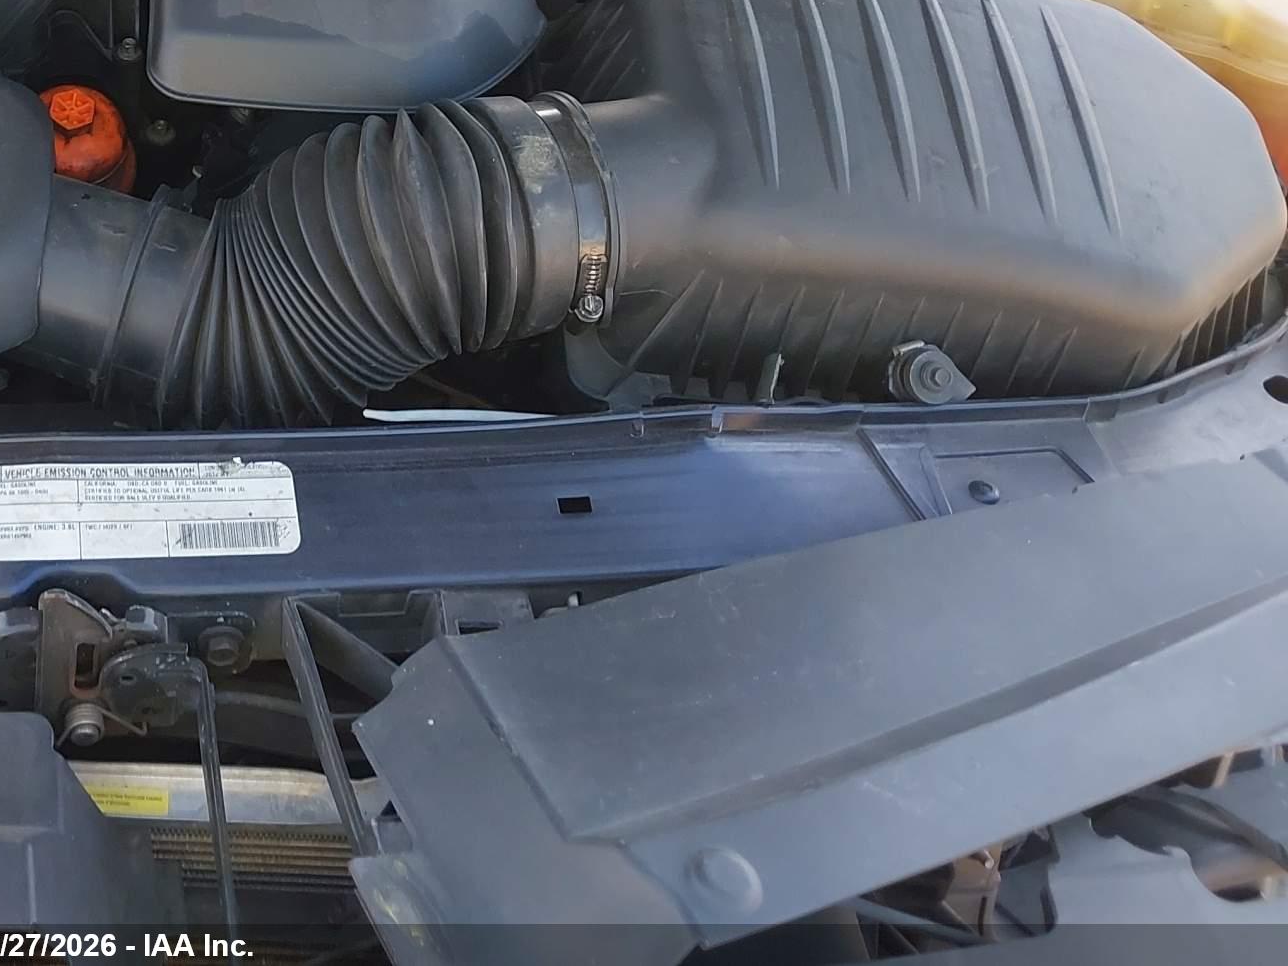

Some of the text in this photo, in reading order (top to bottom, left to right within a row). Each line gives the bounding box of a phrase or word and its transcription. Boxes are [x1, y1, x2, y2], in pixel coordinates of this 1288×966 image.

[5, 468, 41, 480] VEHICLE
[44, 466, 87, 478] EMISSION
[91, 466, 130, 478] CONTROL
[134, 466, 195, 478] INFORMATION
